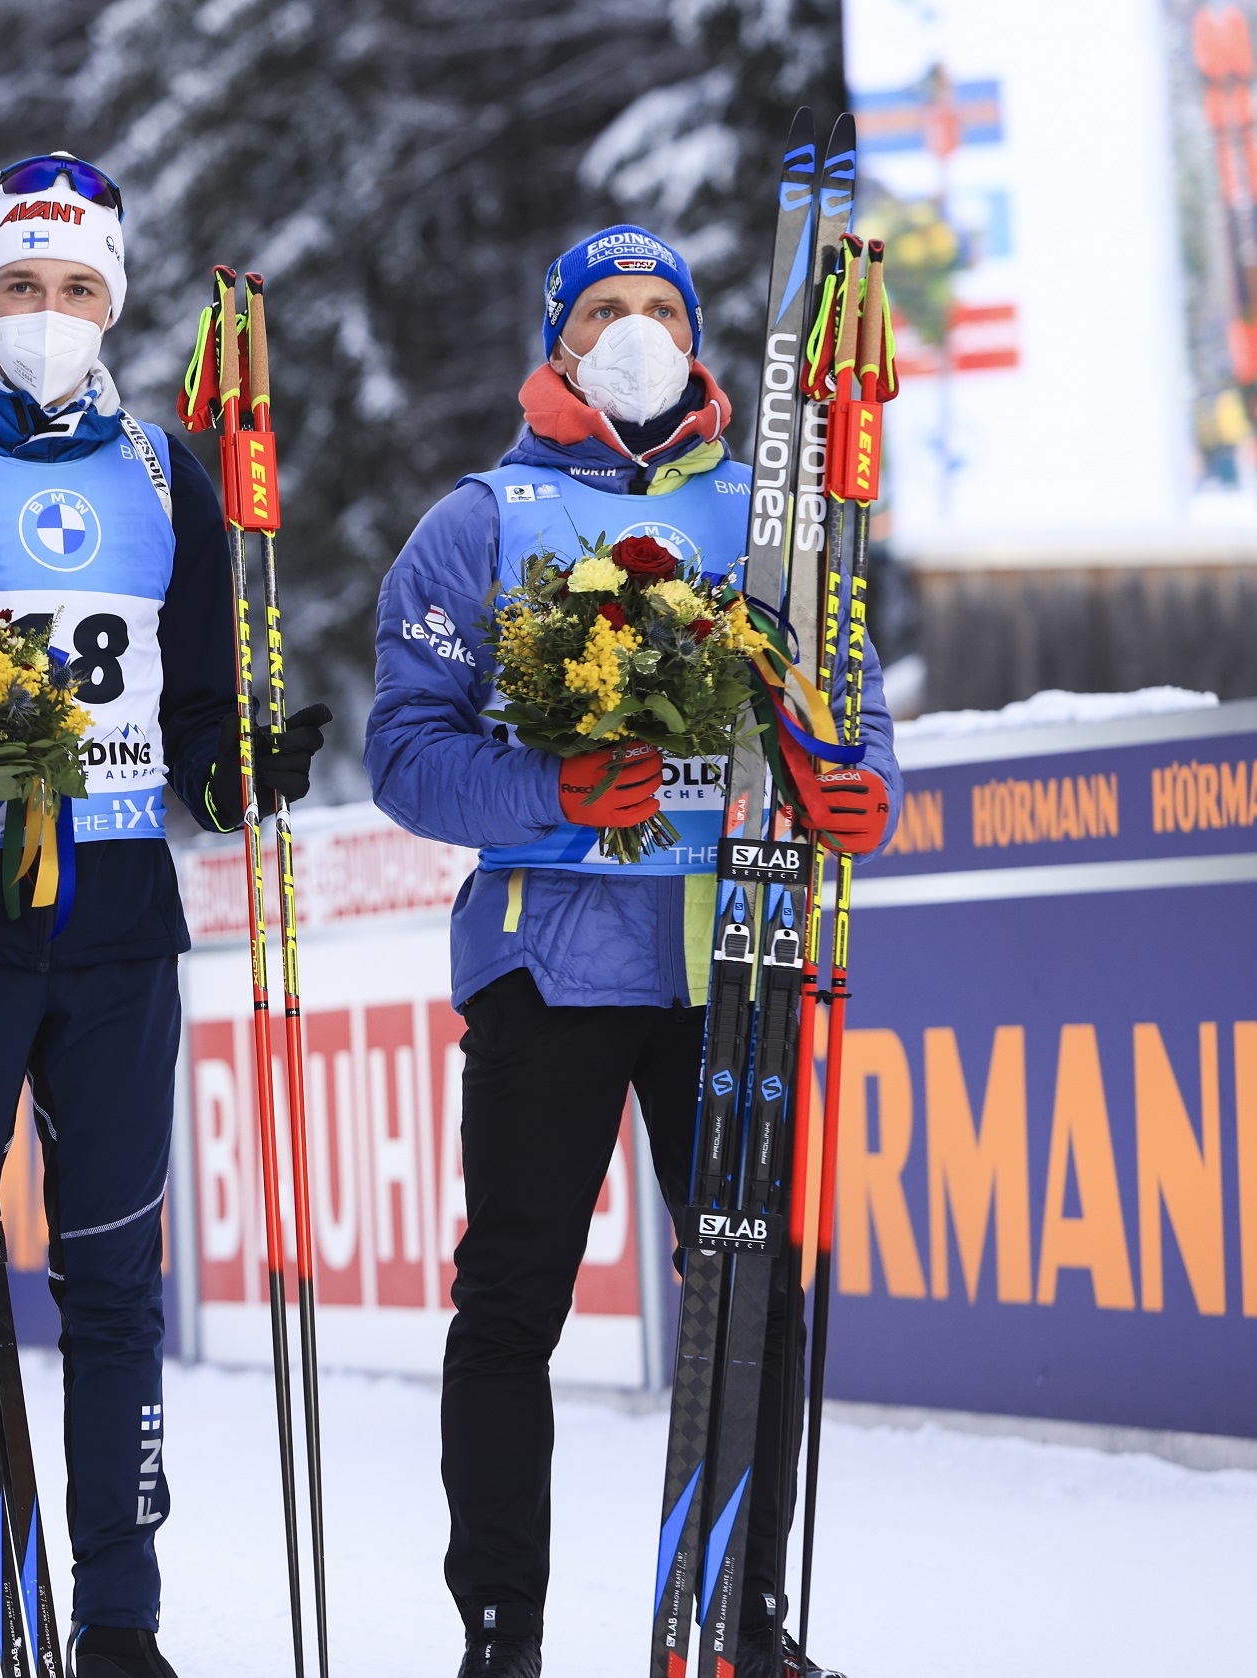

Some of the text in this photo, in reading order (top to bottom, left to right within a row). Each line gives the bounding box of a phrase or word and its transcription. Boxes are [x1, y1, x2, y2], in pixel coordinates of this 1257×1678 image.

[249, 439, 268, 519] LEKI
[856, 408, 873, 491] LEKI
[266, 605, 285, 690] LEKI
[849, 576, 867, 661] LEKI
[972, 772, 1119, 849] HÖRMANN
[731, 869, 799, 880] SELECT
[698, 1238, 766, 1250] SELECT
[136, 1439, 164, 1526] FIN
[672, 1590, 680, 1616] CARBON
[720, 1594, 728, 1621] CARBON
[722, 1574, 730, 1594] SKATE
